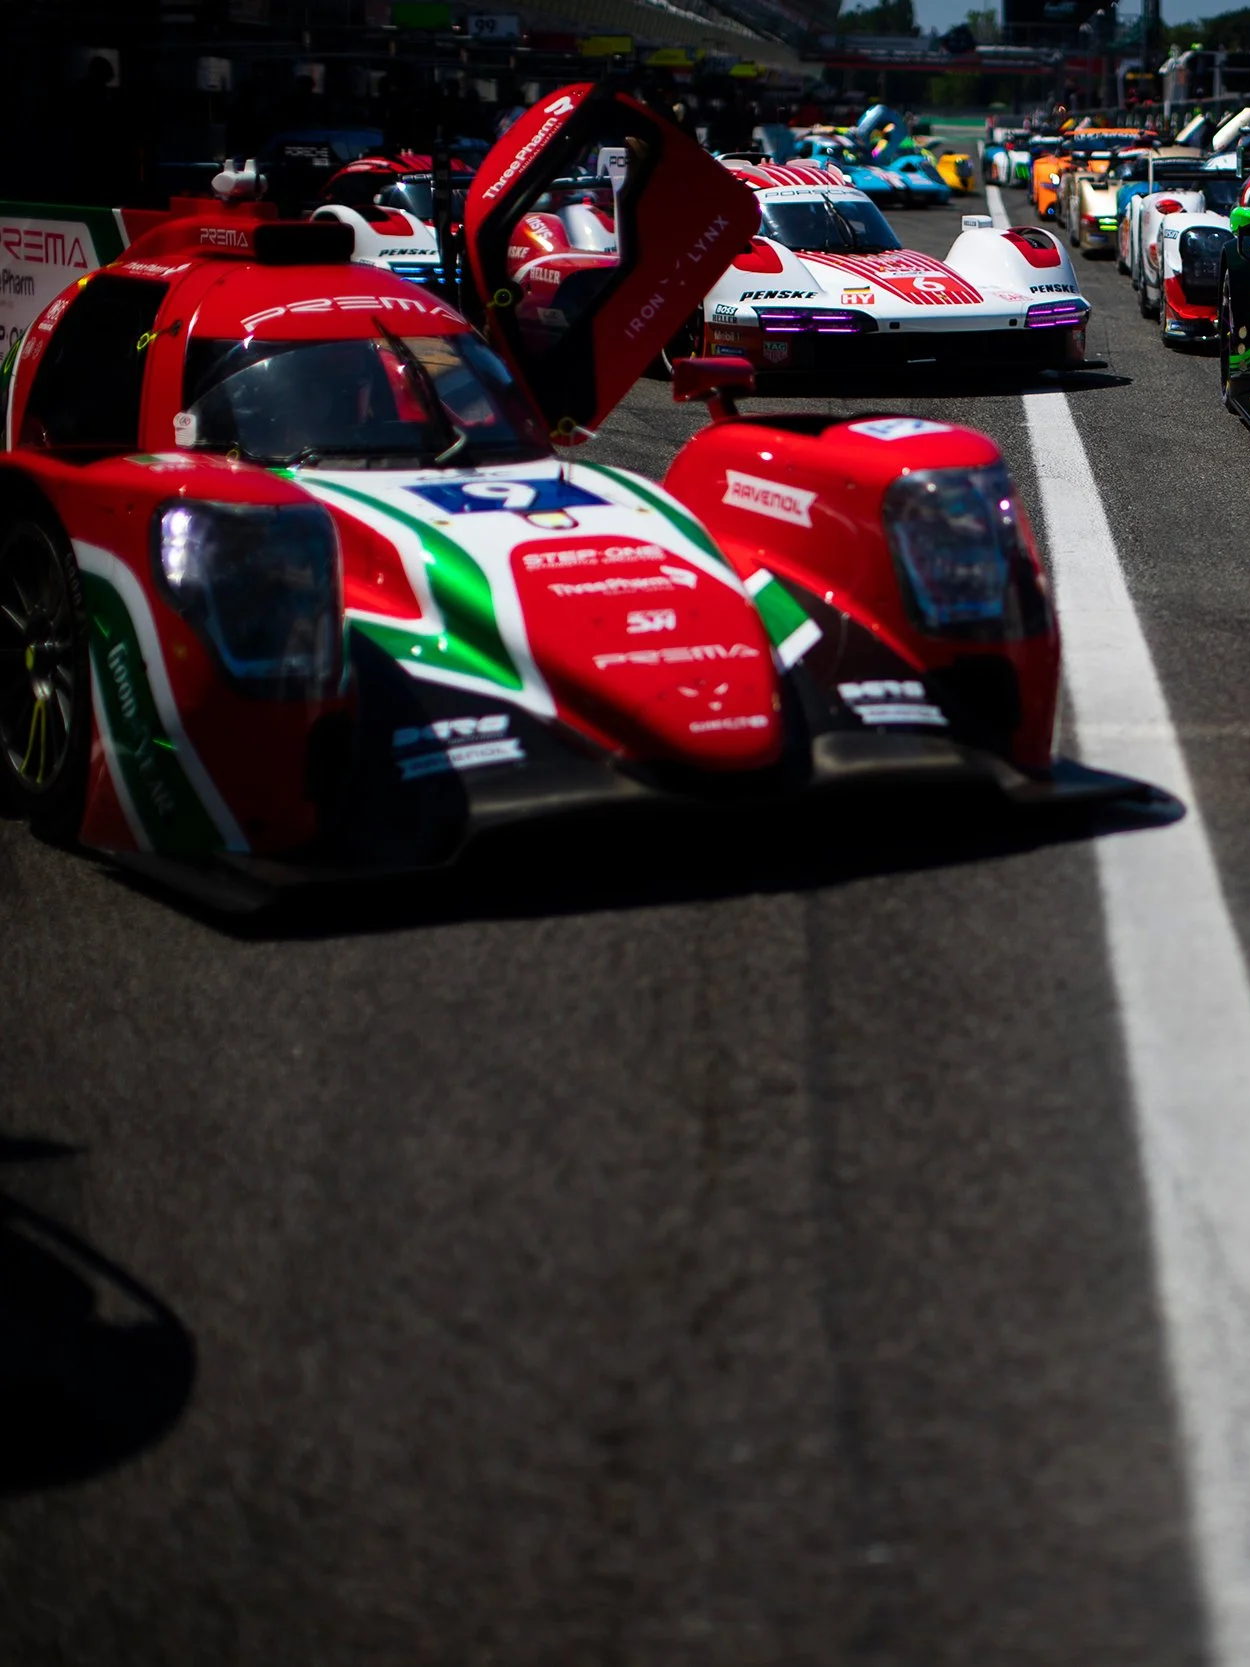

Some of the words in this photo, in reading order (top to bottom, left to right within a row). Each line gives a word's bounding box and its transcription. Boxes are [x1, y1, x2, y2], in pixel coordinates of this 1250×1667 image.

[475, 18, 496, 34] 99
[482, 117, 559, 201] ThreePharm
[0, 227, 88, 269] REMA
[200, 227, 250, 248] PREMA
[686, 214, 730, 264] LYNX
[378, 247, 438, 258] PENSKE
[0, 268, 35, 296] Pharm
[739, 289, 819, 302] PENSKE
[912, 277, 947, 292] 6
[1029, 284, 1077, 295] PENSKE
[716, 304, 736, 316] BOSS
[843, 294, 875, 305] HY
[239, 295, 468, 333] PREMA
[623, 292, 666, 340] IRON
[461, 481, 538, 509] 9
[731, 482, 804, 516] RAVENOL
[591, 643, 761, 671] PREMA
